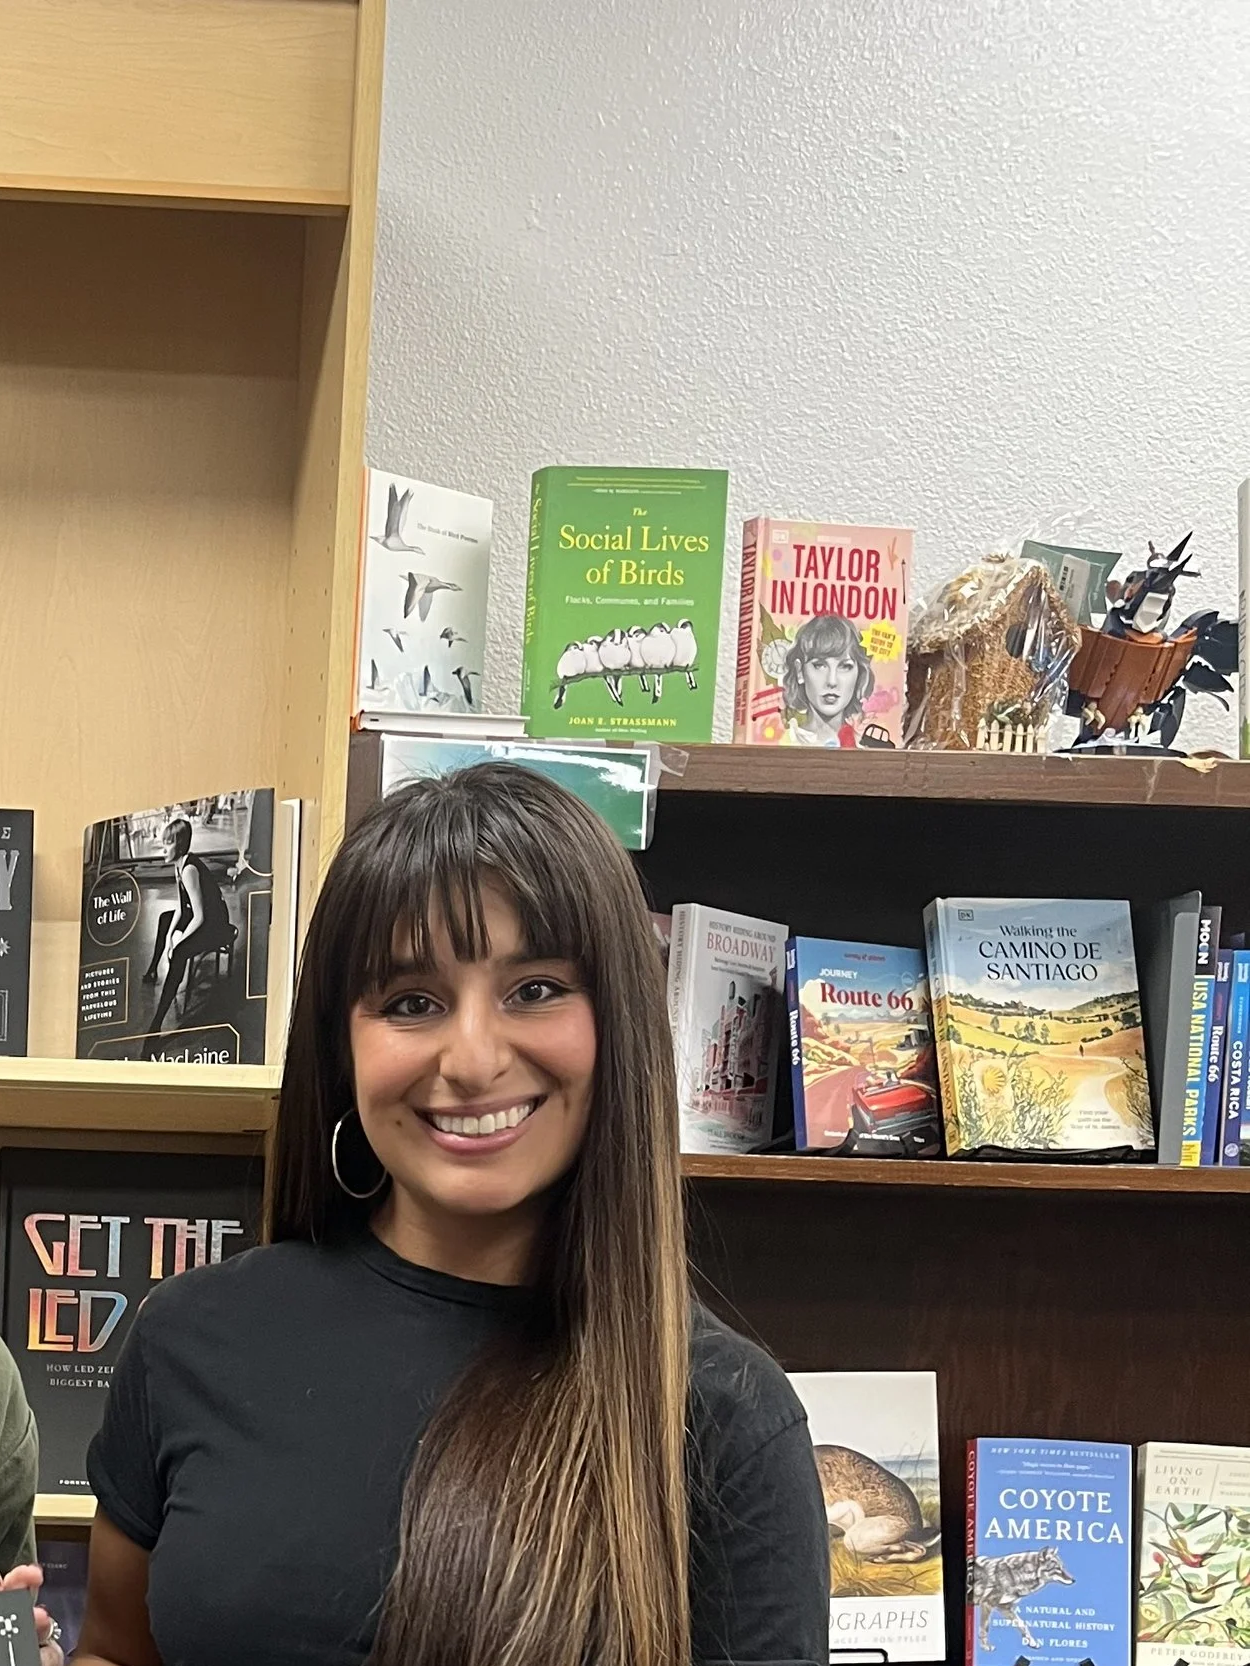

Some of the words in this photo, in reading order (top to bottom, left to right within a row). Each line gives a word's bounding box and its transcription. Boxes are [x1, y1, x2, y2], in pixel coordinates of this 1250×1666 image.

[558, 524, 632, 551] Social
[640, 526, 710, 552] Lives
[586, 559, 615, 585] of
[619, 559, 685, 586] Birds
[792, 544, 881, 583] TAYLOR
[770, 580, 796, 614] IN
[800, 582, 898, 621] LONDON
[568, 716, 593, 727] JOAN
[610, 717, 677, 728] STRASSMANN
[93, 896, 112, 910] The
[110, 890, 133, 906] Wall
[108, 910, 127, 923] Life
[999, 924, 1054, 939] Walking
[1057, 925, 1077, 938] the
[707, 932, 777, 964] BROADWAY
[978, 940, 1067, 961] CAMINO
[1074, 941, 1102, 961] DE
[987, 963, 1098, 981] SANTIAGO
[819, 982, 883, 1008] Route
[887, 990, 914, 1011] 66
[1192, 981, 1208, 1007] USA
[151, 1049, 230, 1065] MacLaine
[1186, 1010, 1207, 1083] NATIONAL
[1209, 1025, 1224, 1063] Route
[1231, 1040, 1243, 1087] COSTA
[1182, 1089, 1200, 1136] PARKS
[1228, 1086, 1240, 1120] RICA
[23, 1213, 131, 1278] GET
[144, 1217, 244, 1280] THE
[27, 1287, 128, 1353] LED
[46, 1363, 71, 1373] HOW
[74, 1364, 95, 1374] LED
[50, 1378, 93, 1388] BIGGEST
[1154, 1465, 1204, 1476] LIVING
[999, 1488, 1112, 1514] COYOTE
[984, 1517, 1124, 1545] AMERICA
[1026, 1606, 1072, 1616] NATURAL
[1074, 1608, 1096, 1617] AND
[1075, 1622, 1115, 1632] HISTORY
[1049, 1638, 1088, 1648] FLORES
[1190, 1650, 1244, 1661] GODFREY
